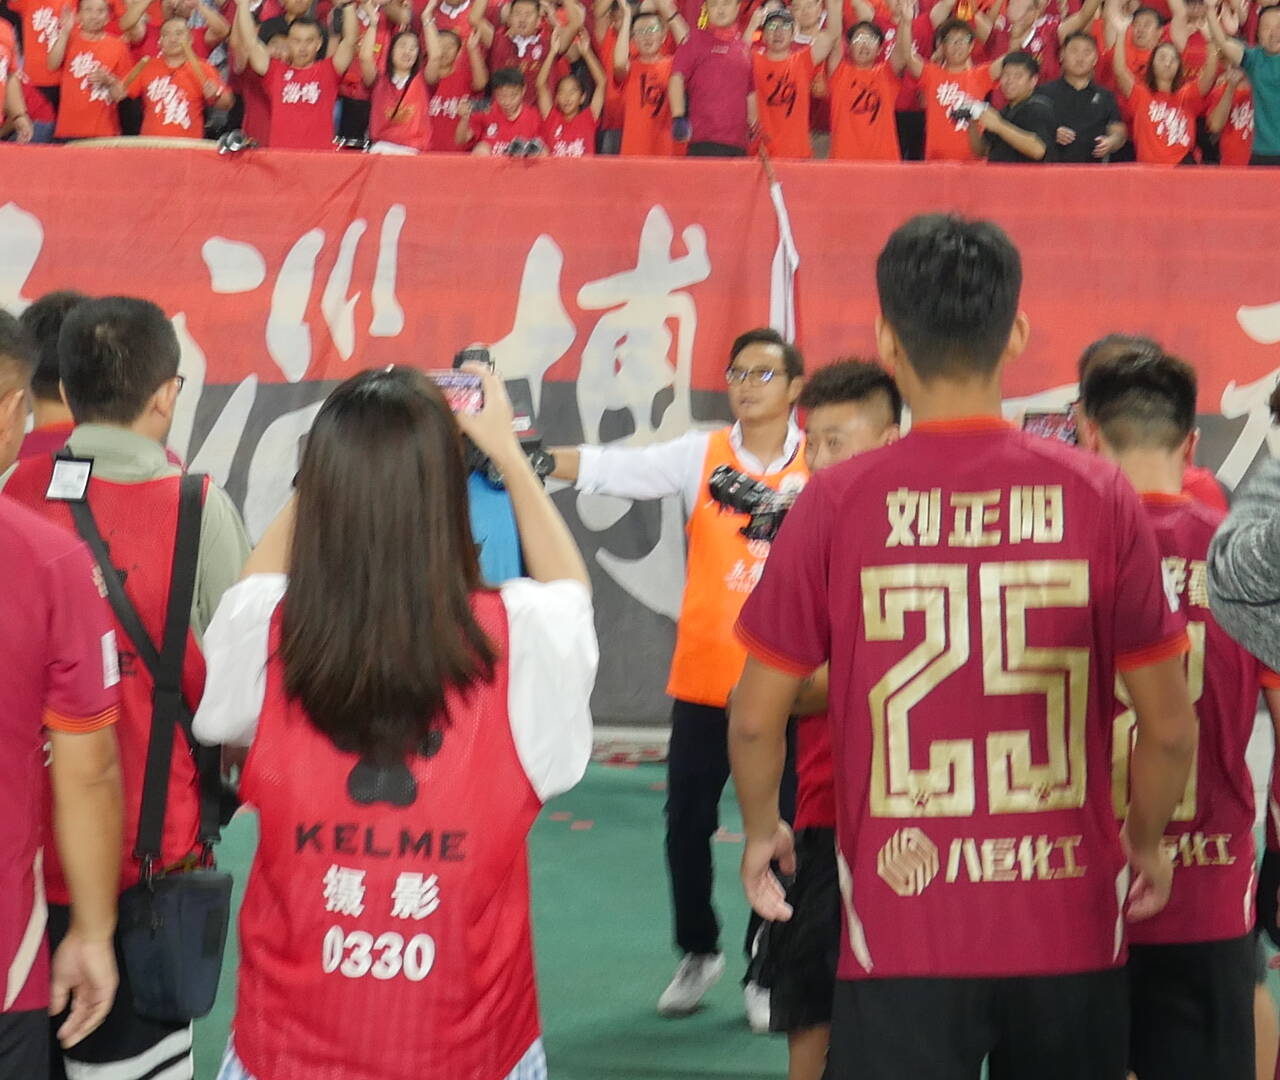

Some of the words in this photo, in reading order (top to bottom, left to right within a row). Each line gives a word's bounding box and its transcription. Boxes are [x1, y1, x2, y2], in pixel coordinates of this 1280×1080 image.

[885, 484, 1064, 548] 刘正阳
[860, 559, 1090, 818] 25
[294, 821, 469, 863] KELME
[322, 864, 442, 920] 摄影
[322, 924, 437, 982] 0330
